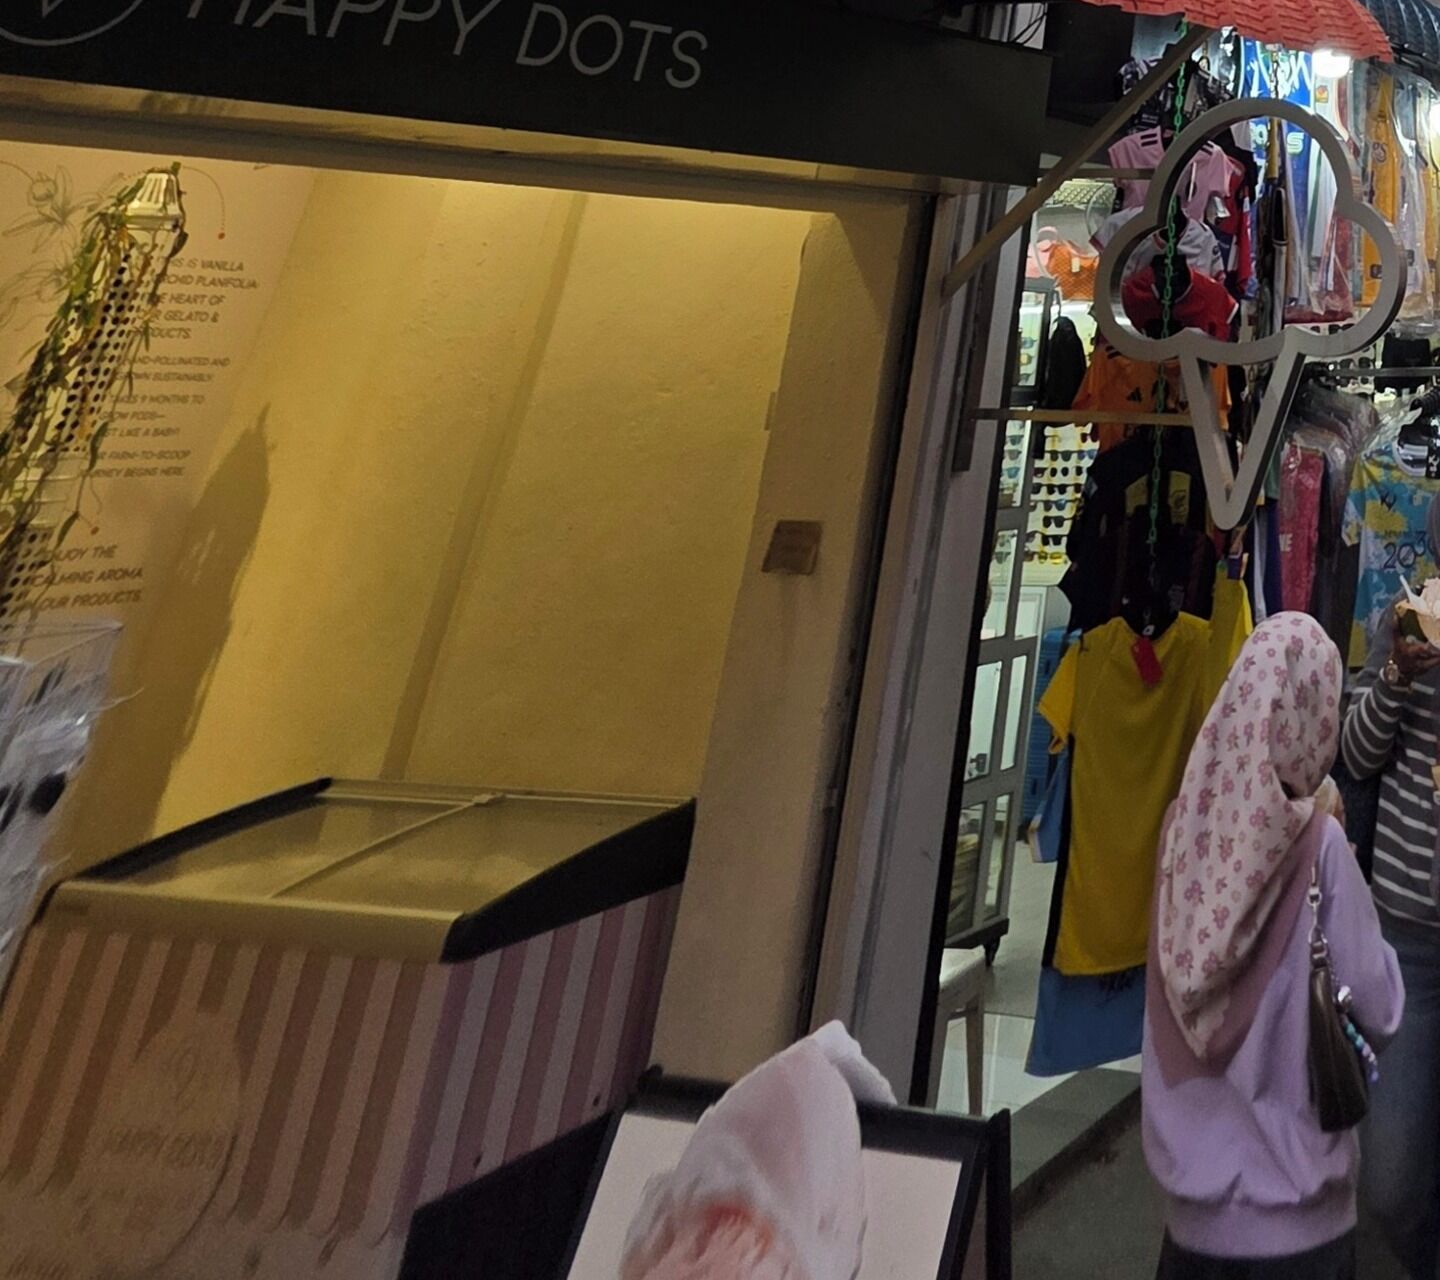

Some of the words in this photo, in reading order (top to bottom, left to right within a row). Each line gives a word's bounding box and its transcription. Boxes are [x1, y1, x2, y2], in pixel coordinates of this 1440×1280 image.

[515, 3, 709, 89] DOTS
[200, 260, 244, 272] VANILLA
[209, 294, 226, 306] OF
[164, 310, 210, 322] GELATO
[92, 544, 118, 559] THE
[95, 567, 143, 583] AROMA
